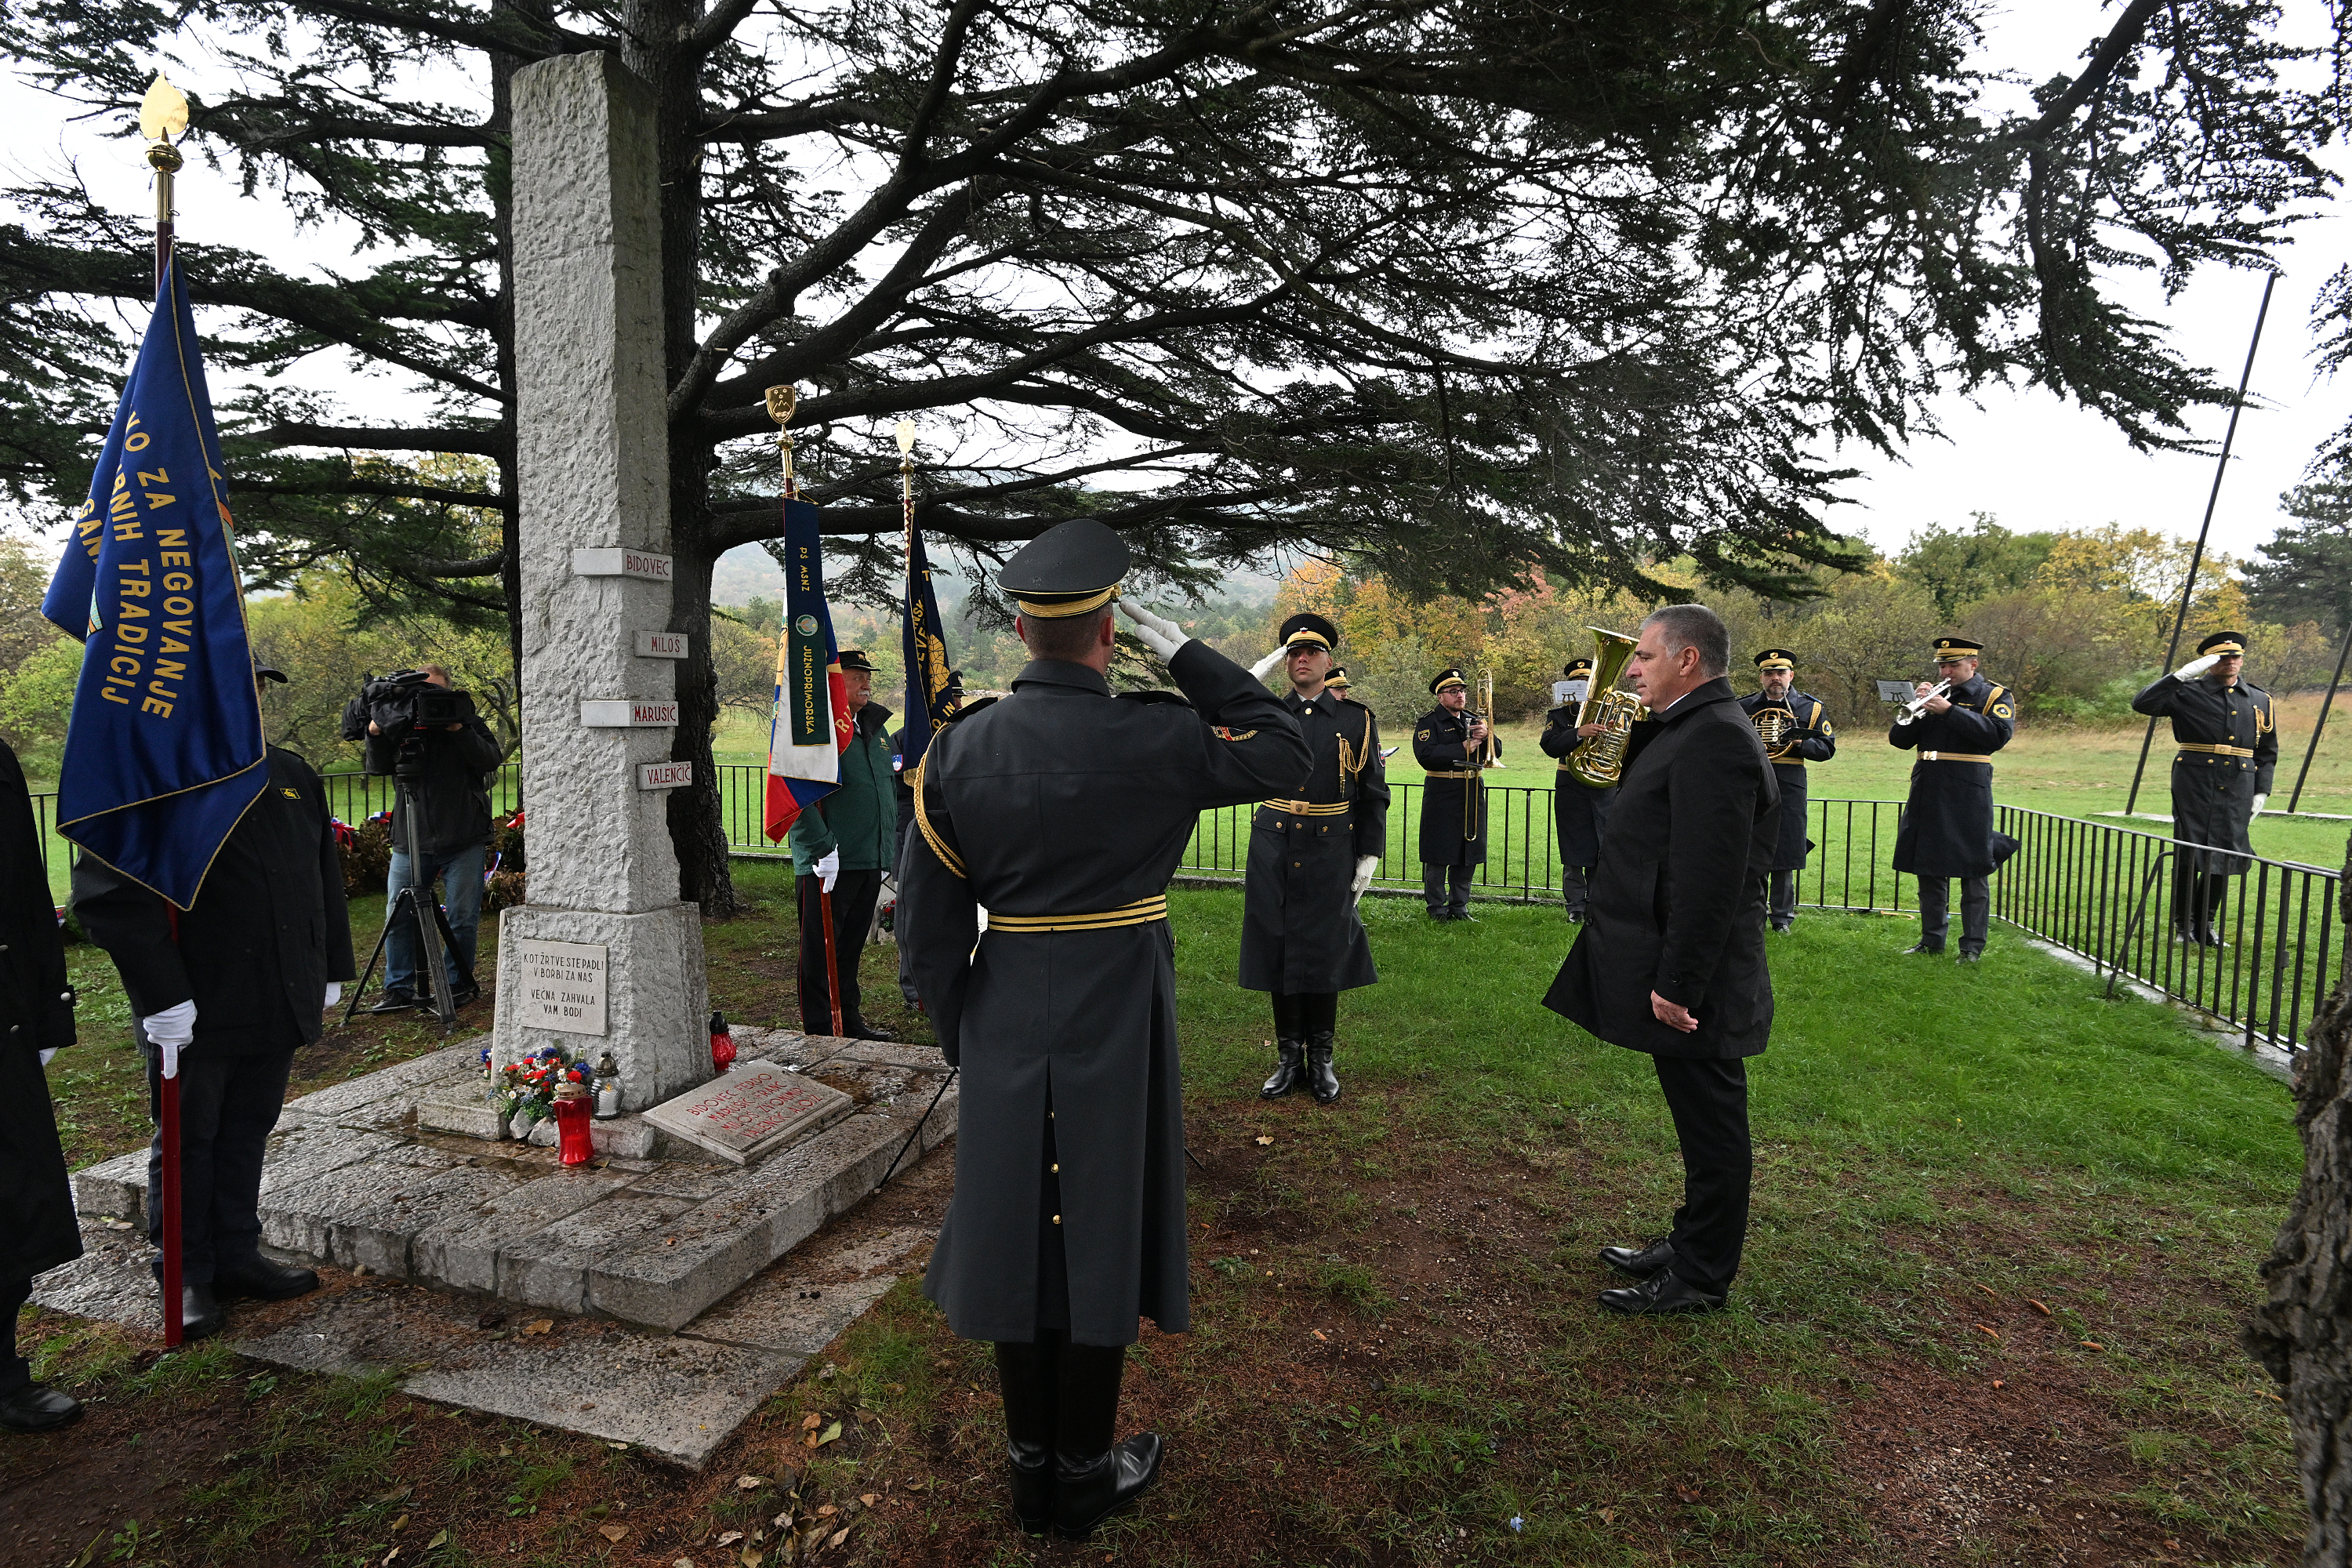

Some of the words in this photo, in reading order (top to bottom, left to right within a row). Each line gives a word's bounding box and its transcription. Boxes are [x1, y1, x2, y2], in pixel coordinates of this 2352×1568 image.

[136, 467, 176, 510] ZA
[626, 554, 670, 576] BIDOVEC
[800, 564, 810, 592] MSNZ
[100, 558, 151, 705] TRADICIJ
[140, 528, 194, 719] NEGOVANJE
[652, 635, 681, 653] MILOŠ
[803, 645, 815, 735] JUŽNOPRIMORSKA
[634, 704, 677, 722] MARUŠIČ
[648, 764, 691, 785] VALENČIČ
[524, 953, 539, 964] KOT
[540, 952, 564, 967] ŽRTVE
[566, 957, 581, 968] STE
[582, 959, 604, 971] PADLI
[534, 967, 539, 977] V
[540, 968, 564, 979] BORBI
[565, 971, 575, 981] ZA
[578, 972, 593, 982] NAS
[531, 987, 556, 1001] VEČNA
[561, 992, 595, 1005] ZAHVALA
[543, 1004, 558, 1015] VAM
[564, 1006, 582, 1018] BODI
[686, 1090, 739, 1116] BIDOVEC
[734, 1073, 772, 1092] FERDO
[754, 1081, 788, 1098] FRANC
[756, 1087, 806, 1112] ZVONIMIR
